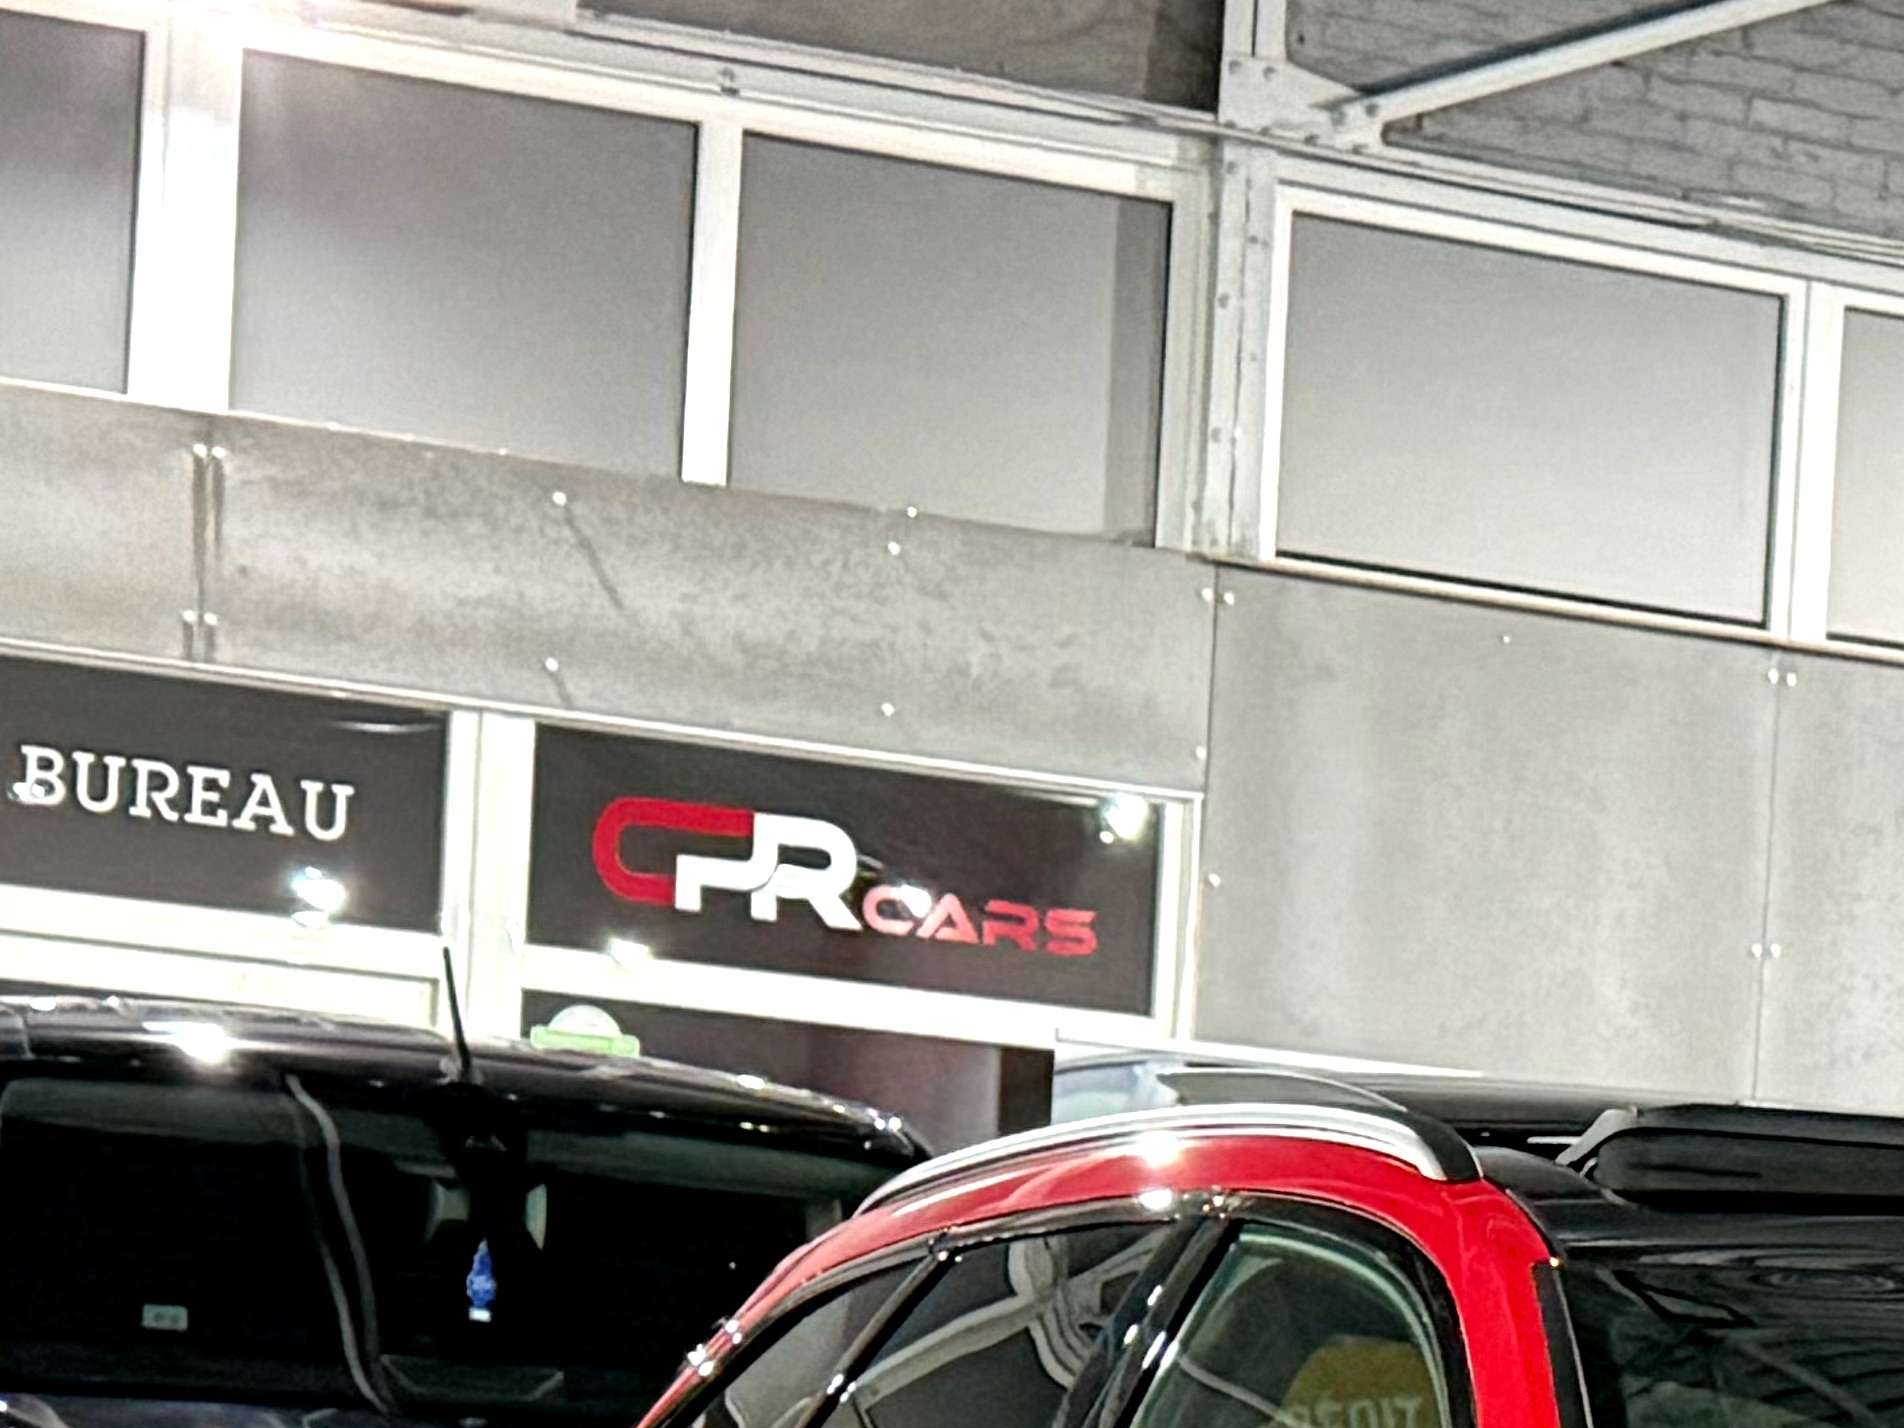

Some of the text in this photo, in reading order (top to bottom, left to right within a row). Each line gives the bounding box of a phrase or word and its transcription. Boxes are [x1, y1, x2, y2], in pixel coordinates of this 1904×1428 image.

[19, 744, 355, 842] BUREAU
[592, 797, 1099, 958] CPR CARS
